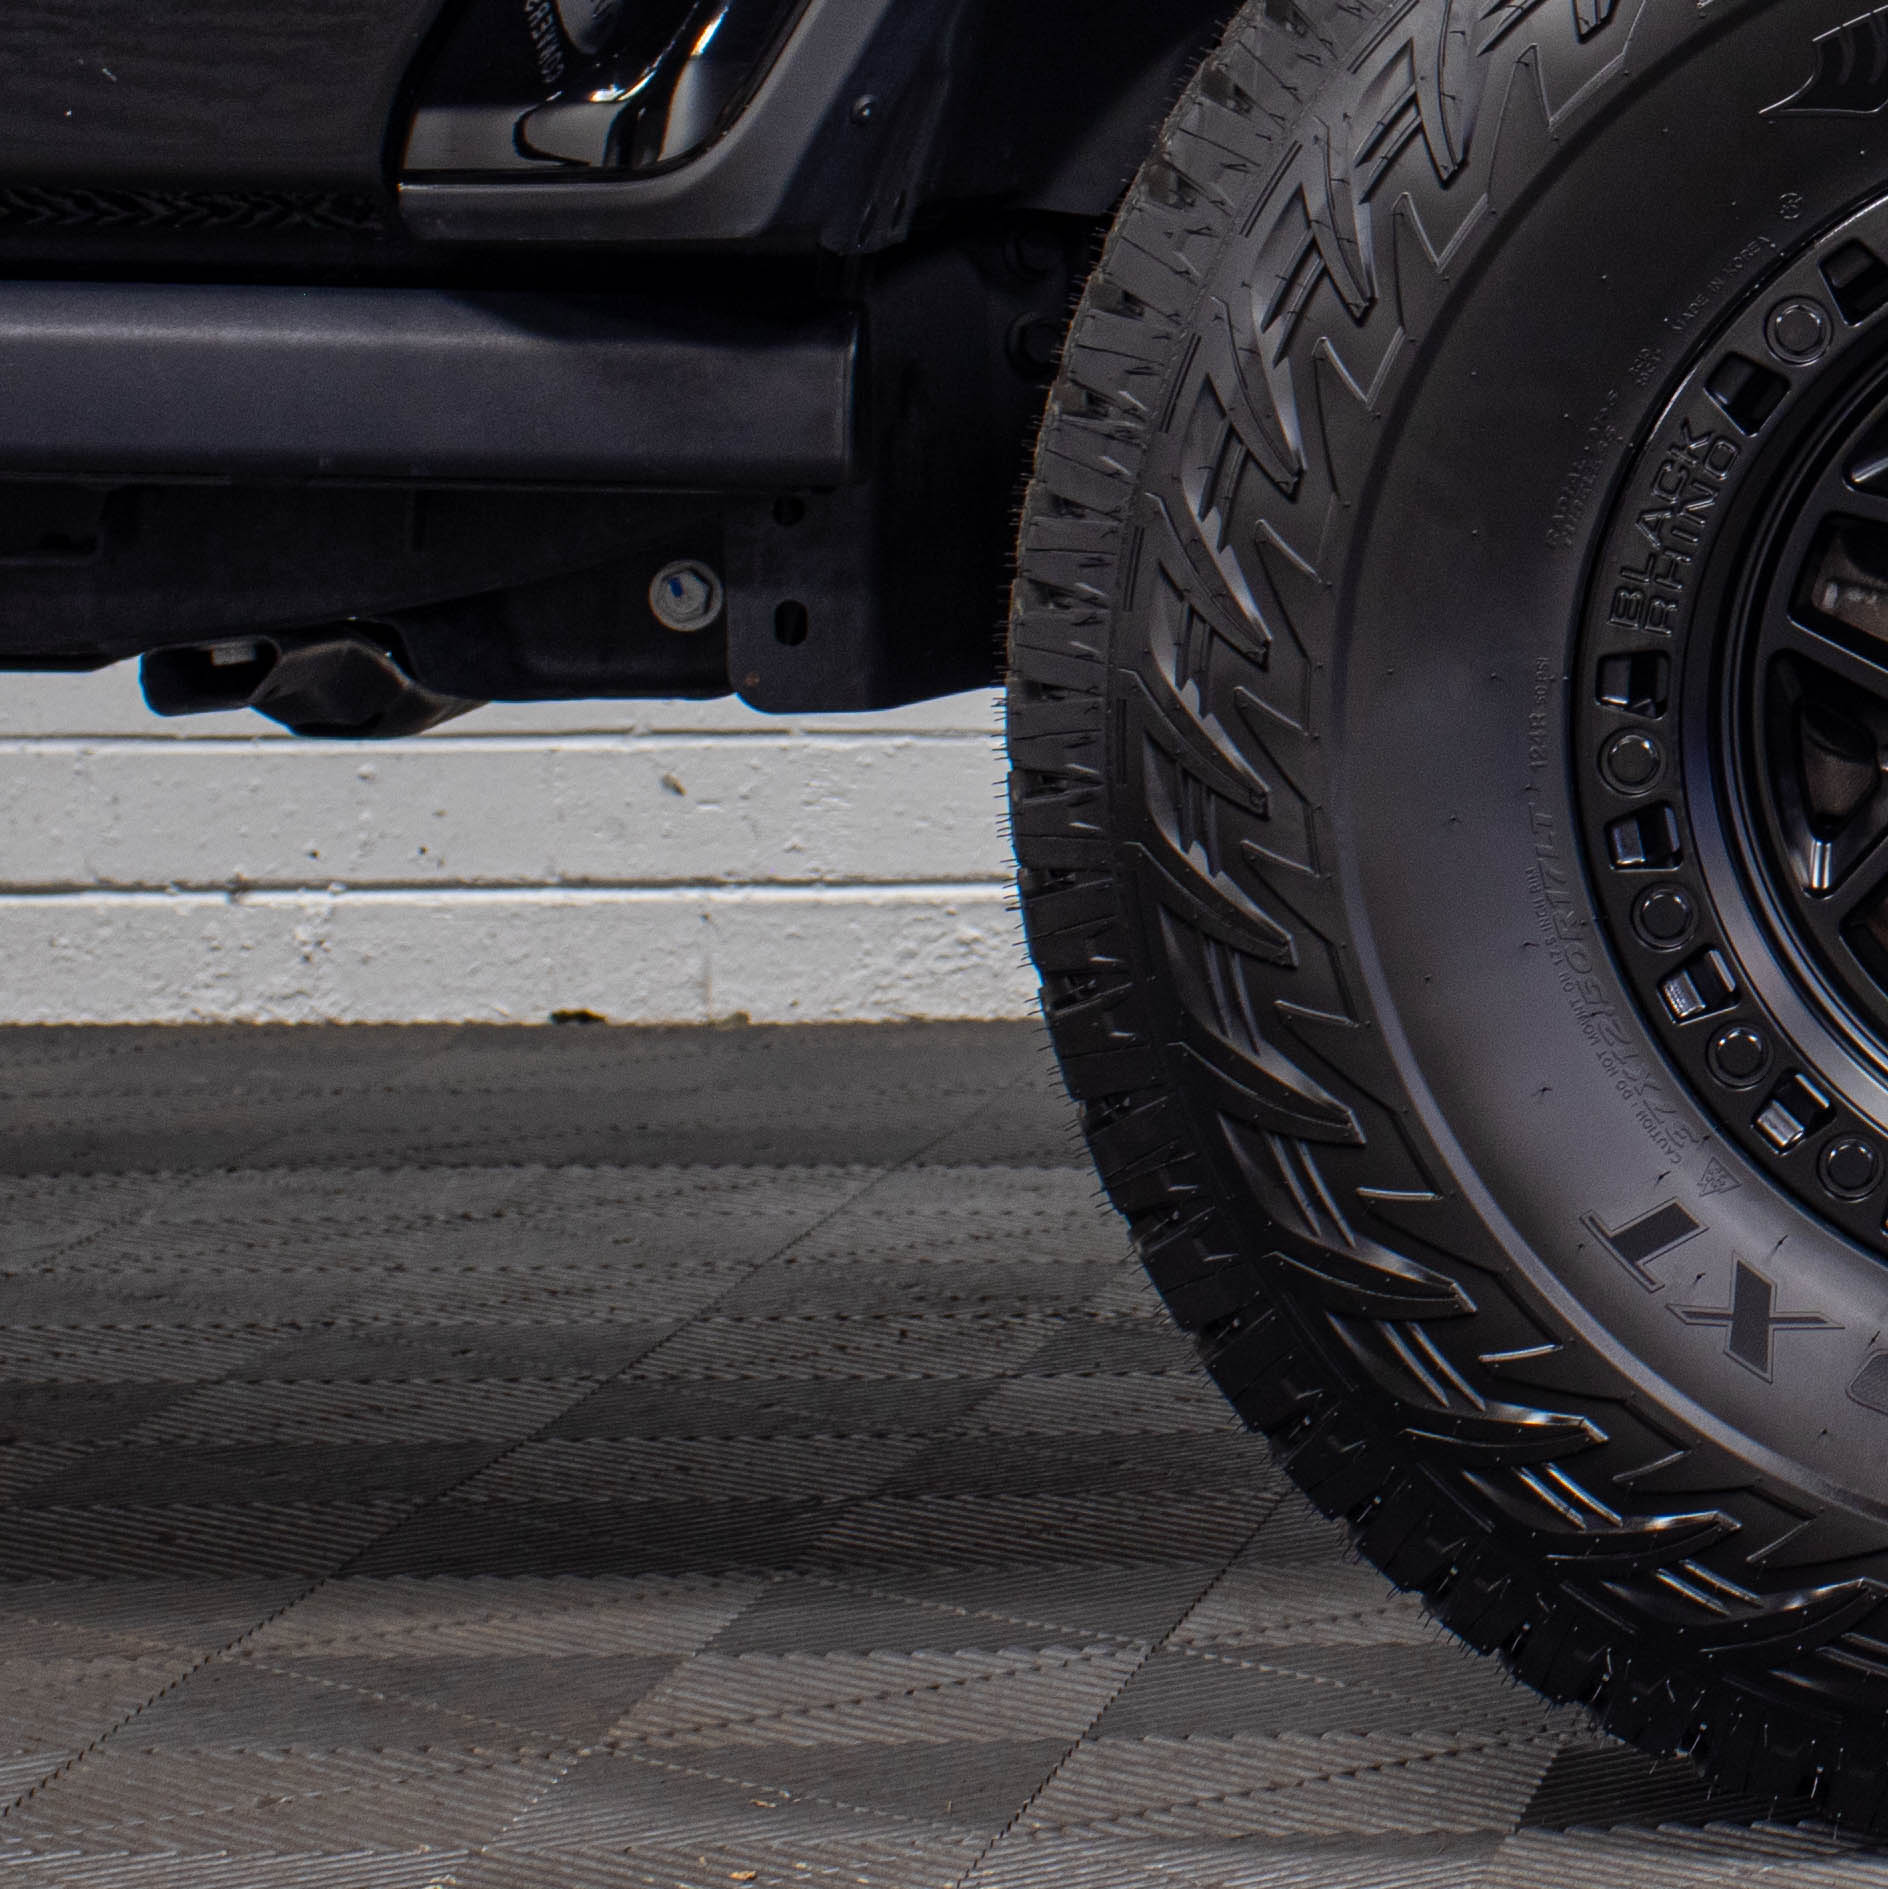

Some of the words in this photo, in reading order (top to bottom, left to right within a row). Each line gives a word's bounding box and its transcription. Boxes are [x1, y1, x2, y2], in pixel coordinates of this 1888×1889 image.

[1609, 416, 1711, 633] BLACK
[1643, 434, 1742, 637] RHINO
[1634, 1108, 1684, 1166] CAUTION
[1578, 1195, 1846, 1385] XT
